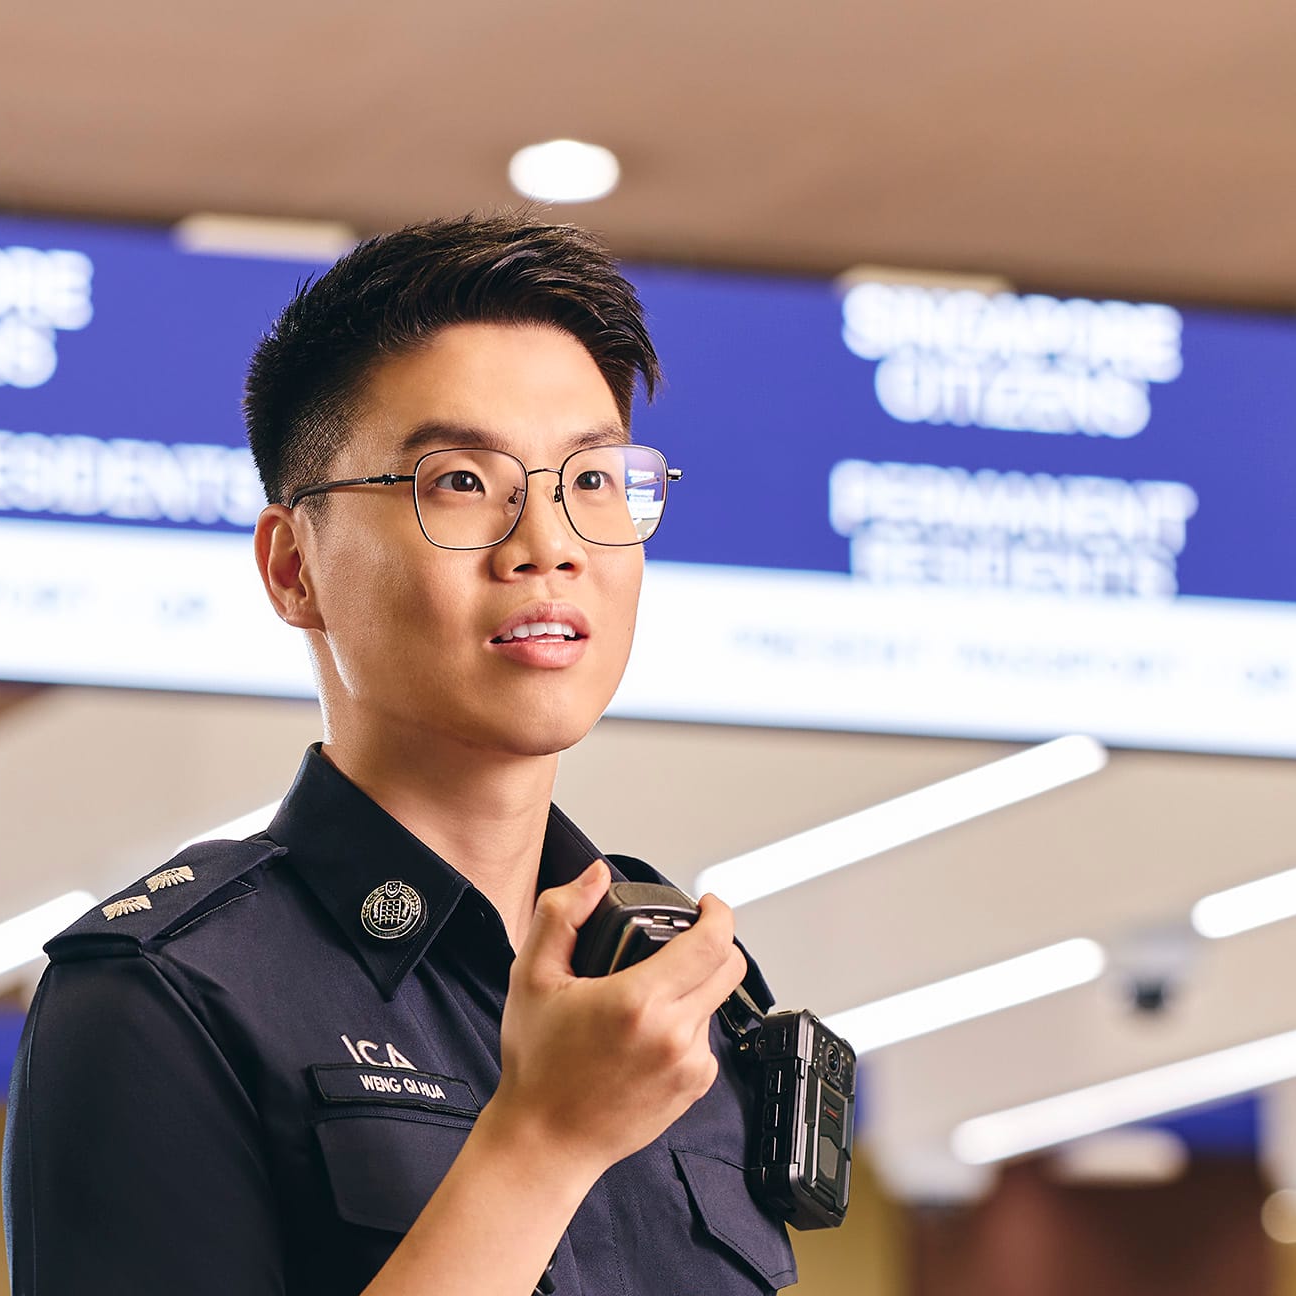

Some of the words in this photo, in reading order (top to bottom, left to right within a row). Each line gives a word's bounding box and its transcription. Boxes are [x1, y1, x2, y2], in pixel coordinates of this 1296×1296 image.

[843, 283, 1183, 381] SINGAPORE
[875, 344, 1151, 437] CITIZENS
[829, 459, 1198, 555] PERMANENT
[341, 1034, 418, 1071] ICA
[359, 1074, 402, 1094] WENG
[402, 1077, 420, 1094] QI
[418, 1081, 447, 1100] HUA
